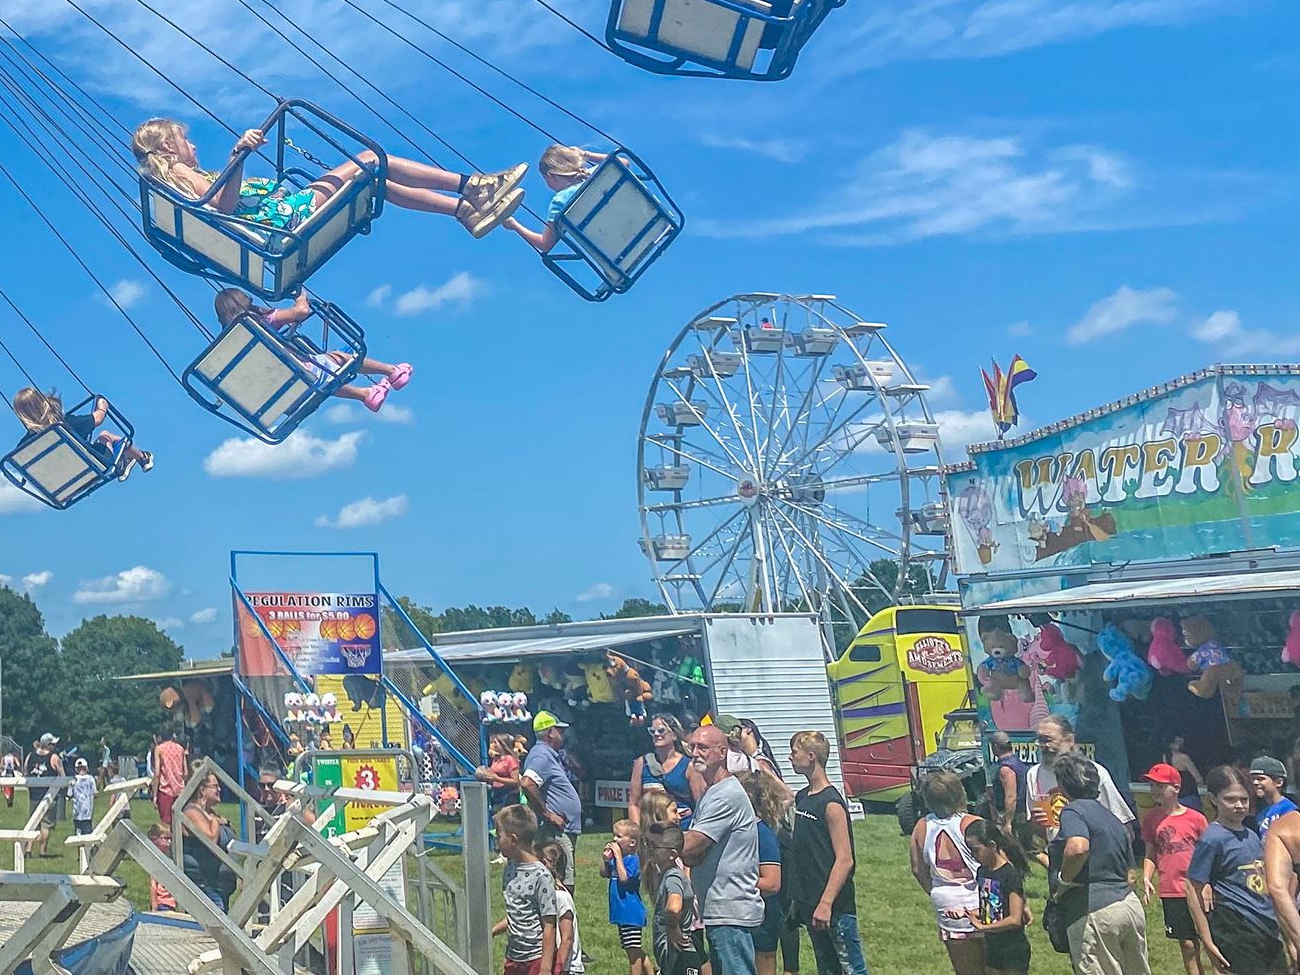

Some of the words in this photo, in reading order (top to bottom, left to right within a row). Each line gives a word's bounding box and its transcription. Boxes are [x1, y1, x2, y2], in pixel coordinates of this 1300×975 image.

[1014, 433, 1222, 518] WATER
[336, 595, 374, 607] RIMS
[269, 611, 275, 620] 3
[277, 611, 304, 621] BALLS
[306, 611, 320, 620] for
[321, 611, 350, 621] $5.00
[907, 651, 964, 668] AMUSEMENTS
[988, 742, 1037, 763] WTER
[360, 770, 375, 791] 3
[598, 786, 623, 802] PRIZE
